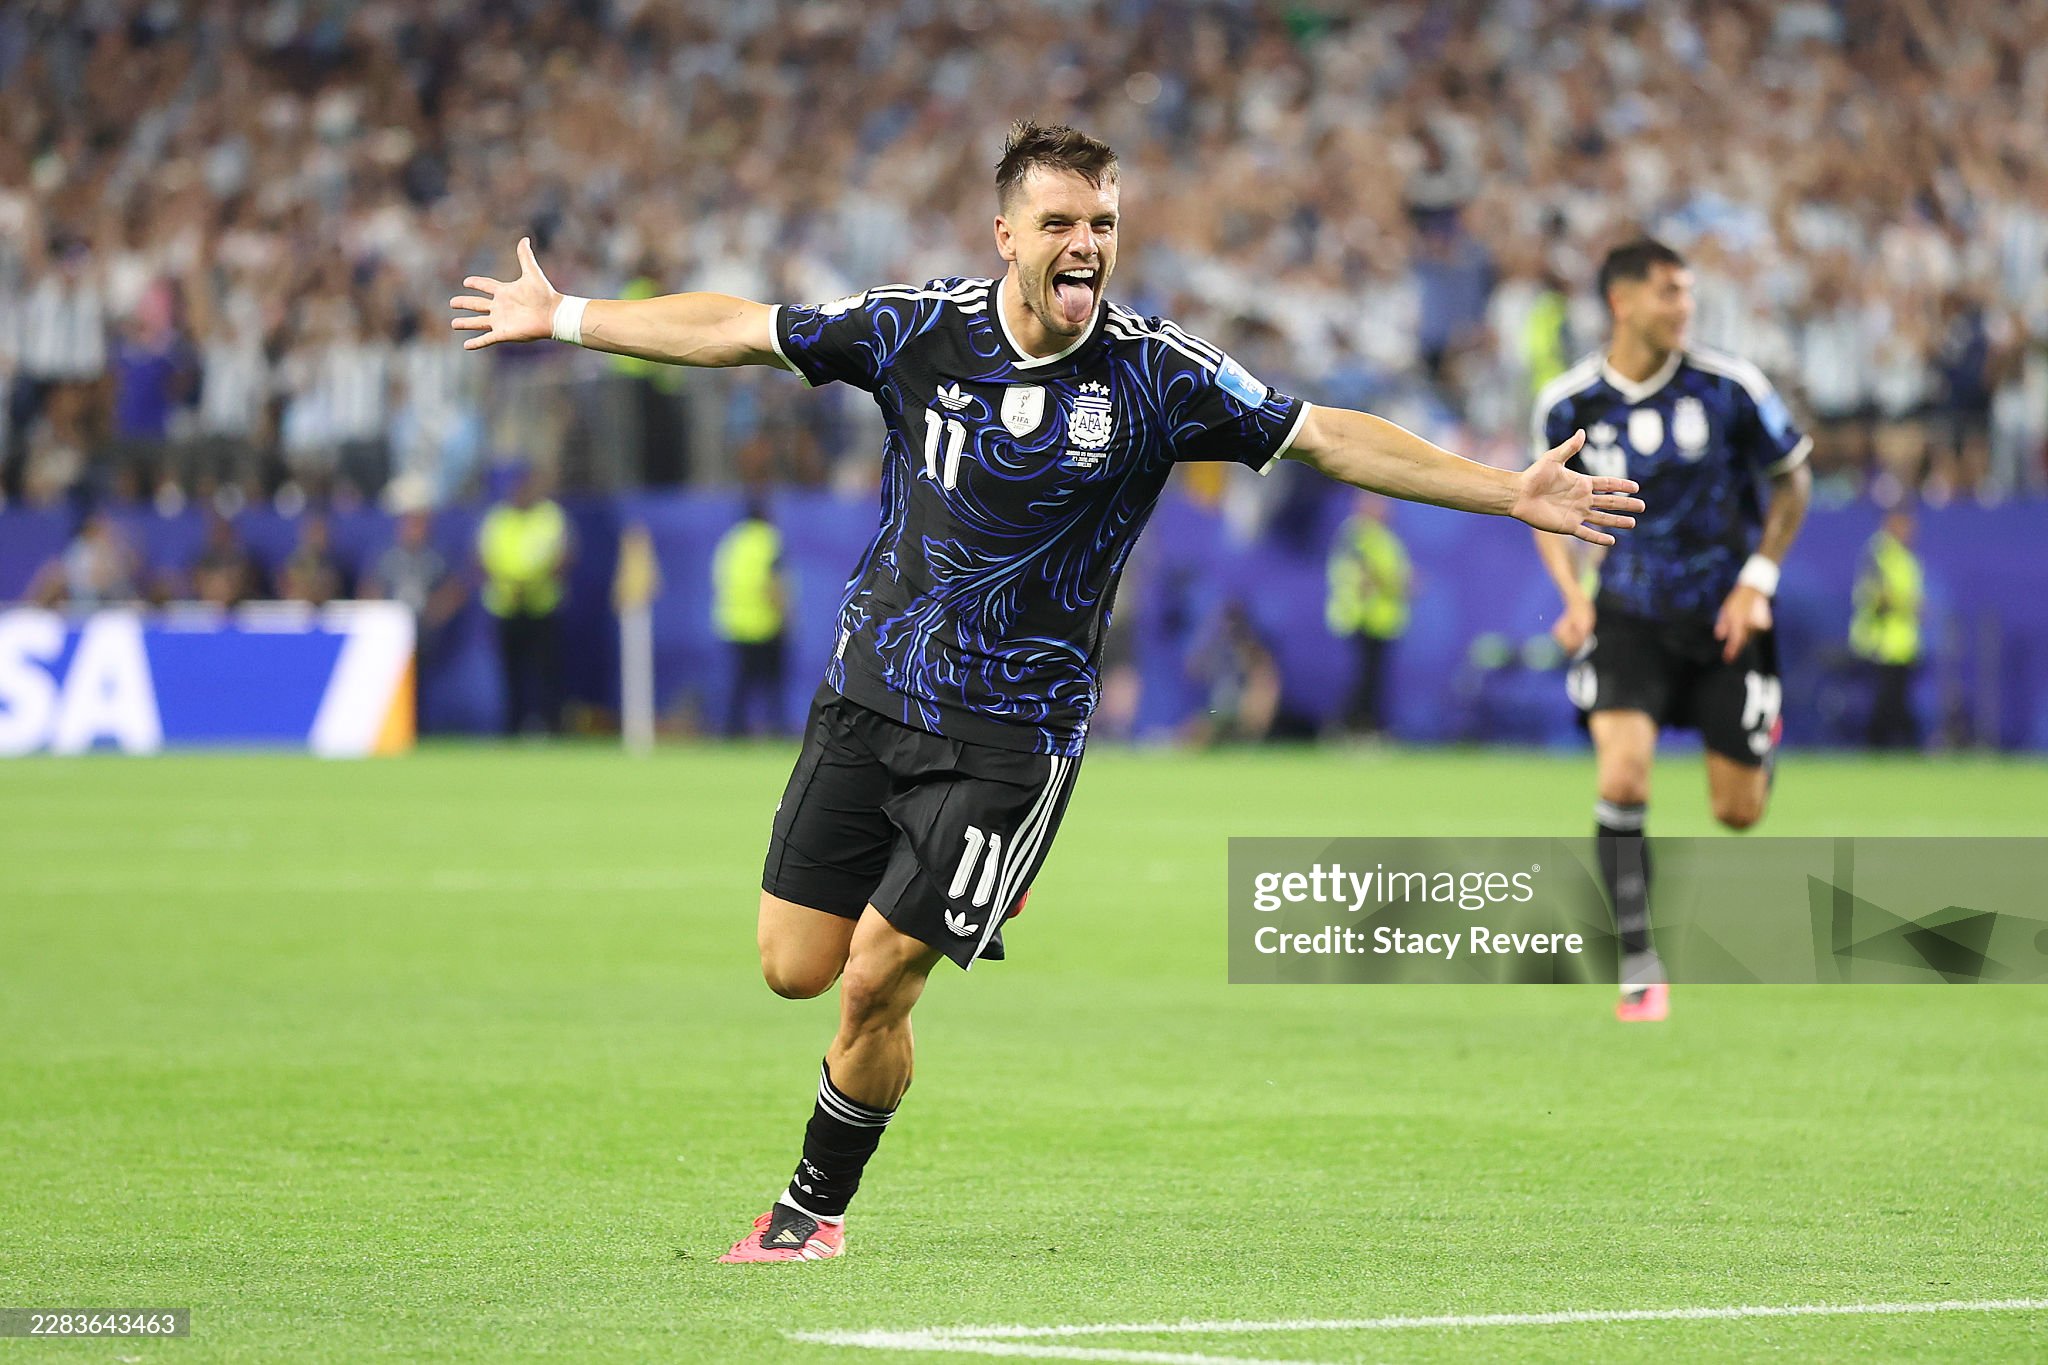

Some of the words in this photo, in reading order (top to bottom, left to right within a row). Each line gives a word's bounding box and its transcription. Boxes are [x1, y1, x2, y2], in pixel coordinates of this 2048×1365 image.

[1012, 415, 1029, 424] FIFA
[1078, 410, 1102, 434] AFA
[925, 408, 967, 490] 11
[947, 824, 1002, 908] 11
